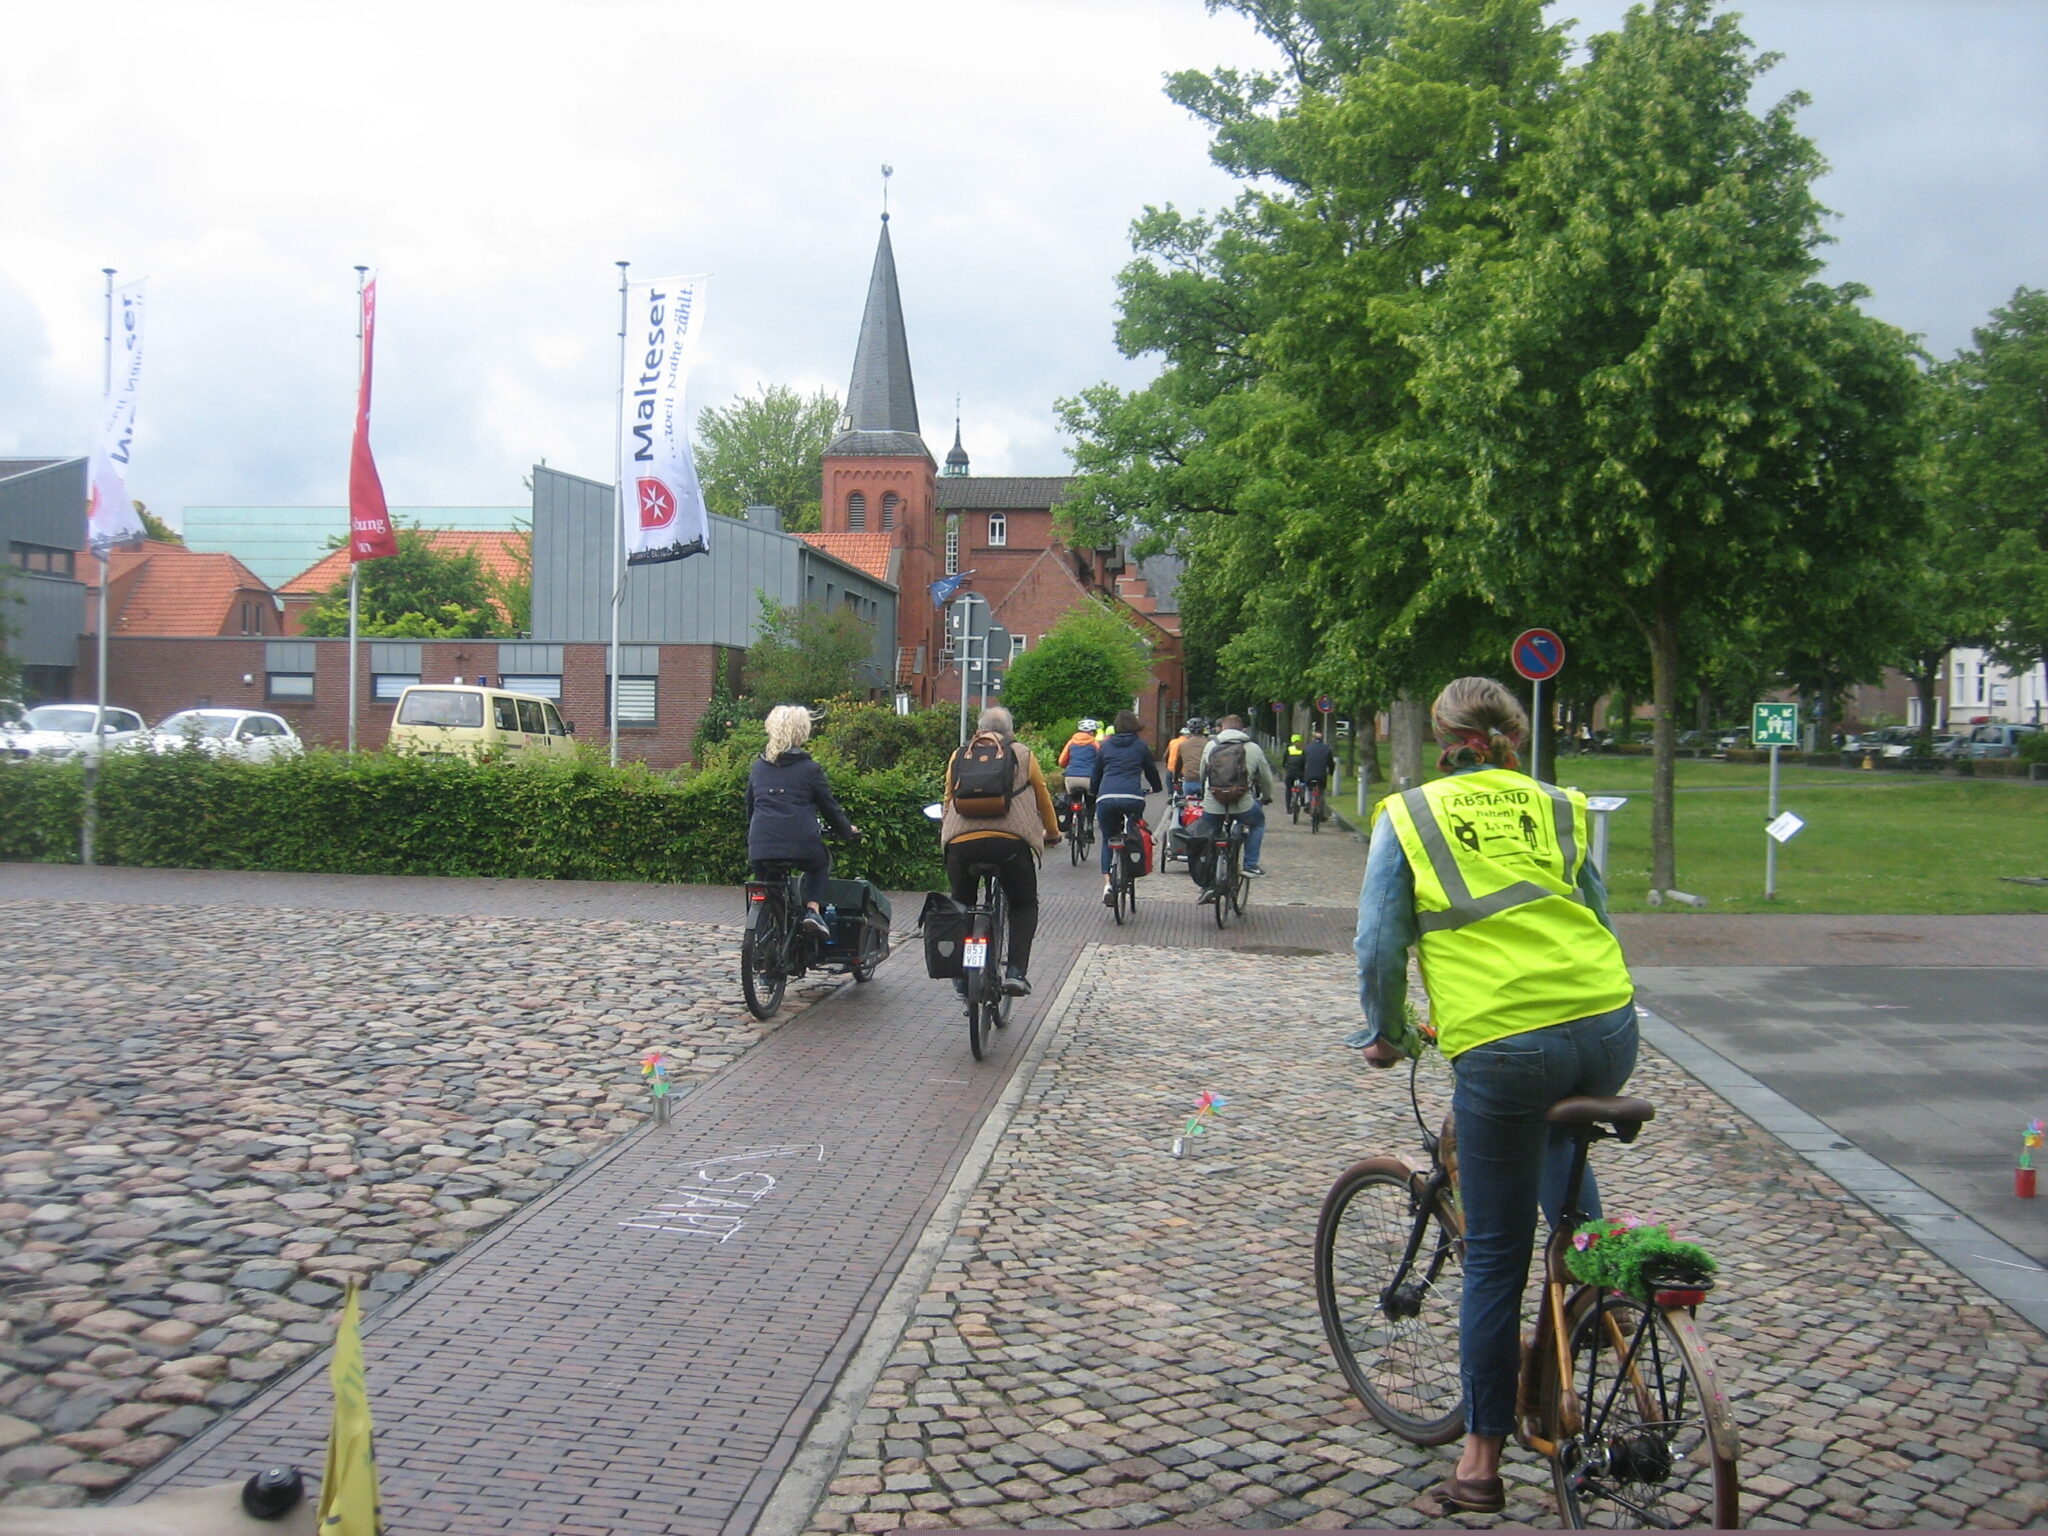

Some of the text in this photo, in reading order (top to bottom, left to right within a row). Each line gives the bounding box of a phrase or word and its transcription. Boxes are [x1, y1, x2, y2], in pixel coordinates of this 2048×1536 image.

[668, 340, 684, 390] Nahe
[676, 283, 695, 335] zählt.
[633, 287, 666, 463] Malteser
[1453, 792, 1529, 807] ABSTAND
[966, 945, 983, 954] 853
[617, 1170, 777, 1246] START
